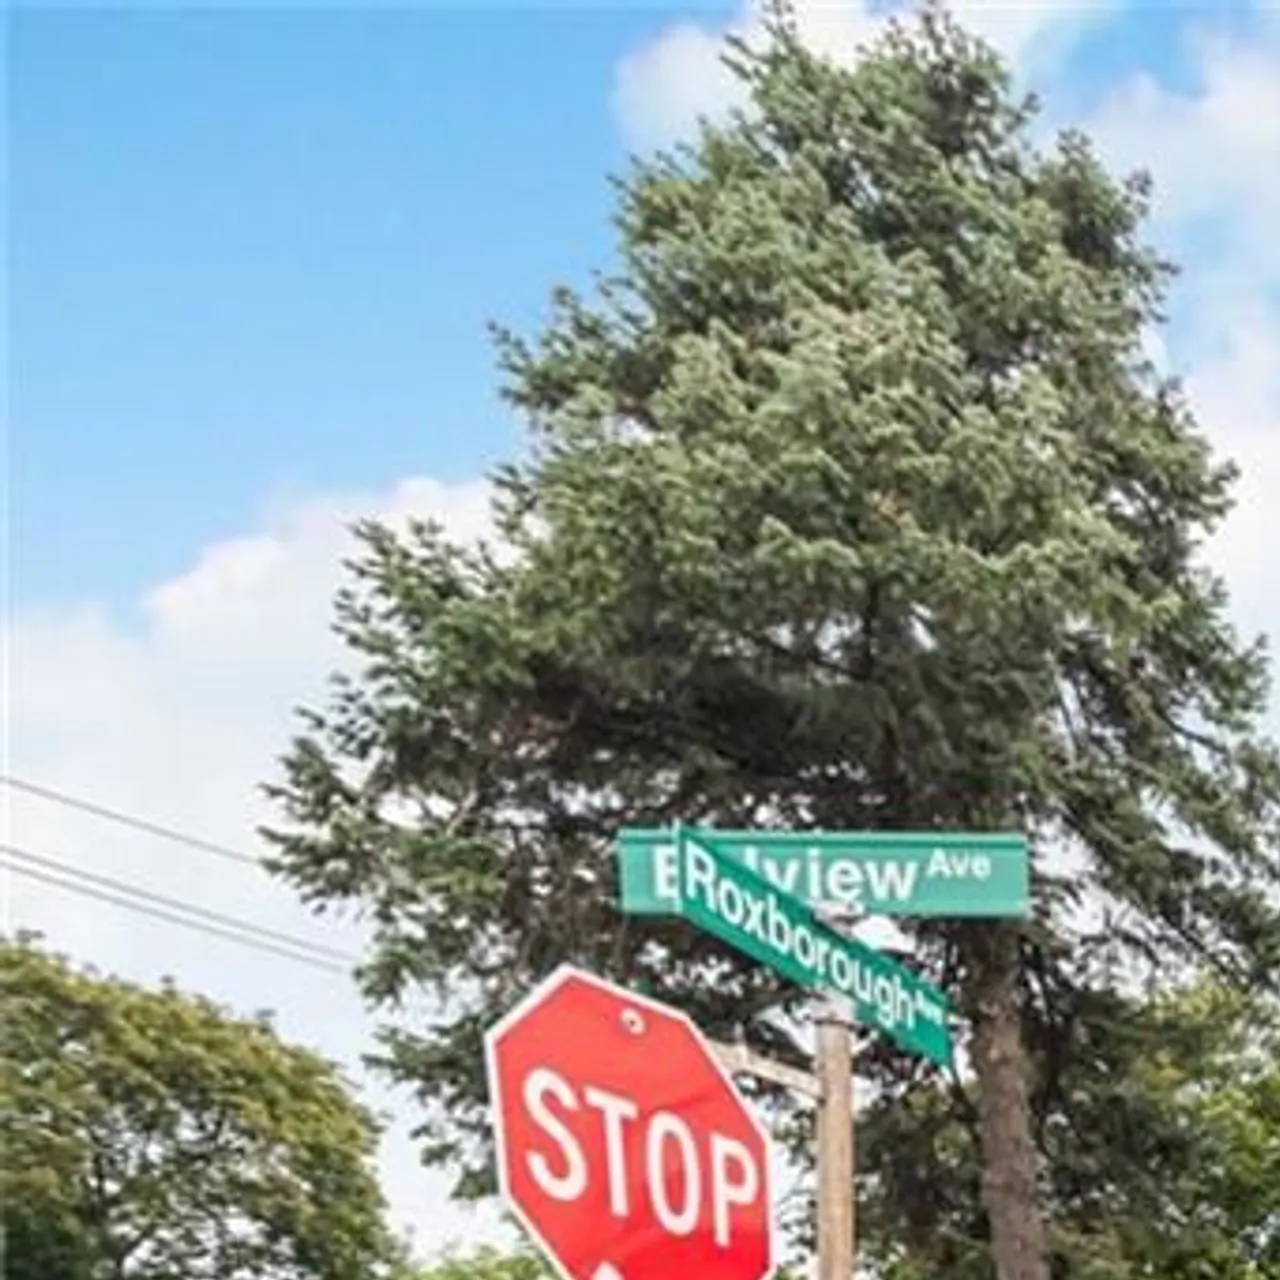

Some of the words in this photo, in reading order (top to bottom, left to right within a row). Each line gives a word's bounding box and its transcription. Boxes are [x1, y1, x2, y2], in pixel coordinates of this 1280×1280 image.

[686, 838, 916, 1031] Roxborough
[927, 848, 992, 878] Ave
[523, 1067, 759, 1249] STOP
